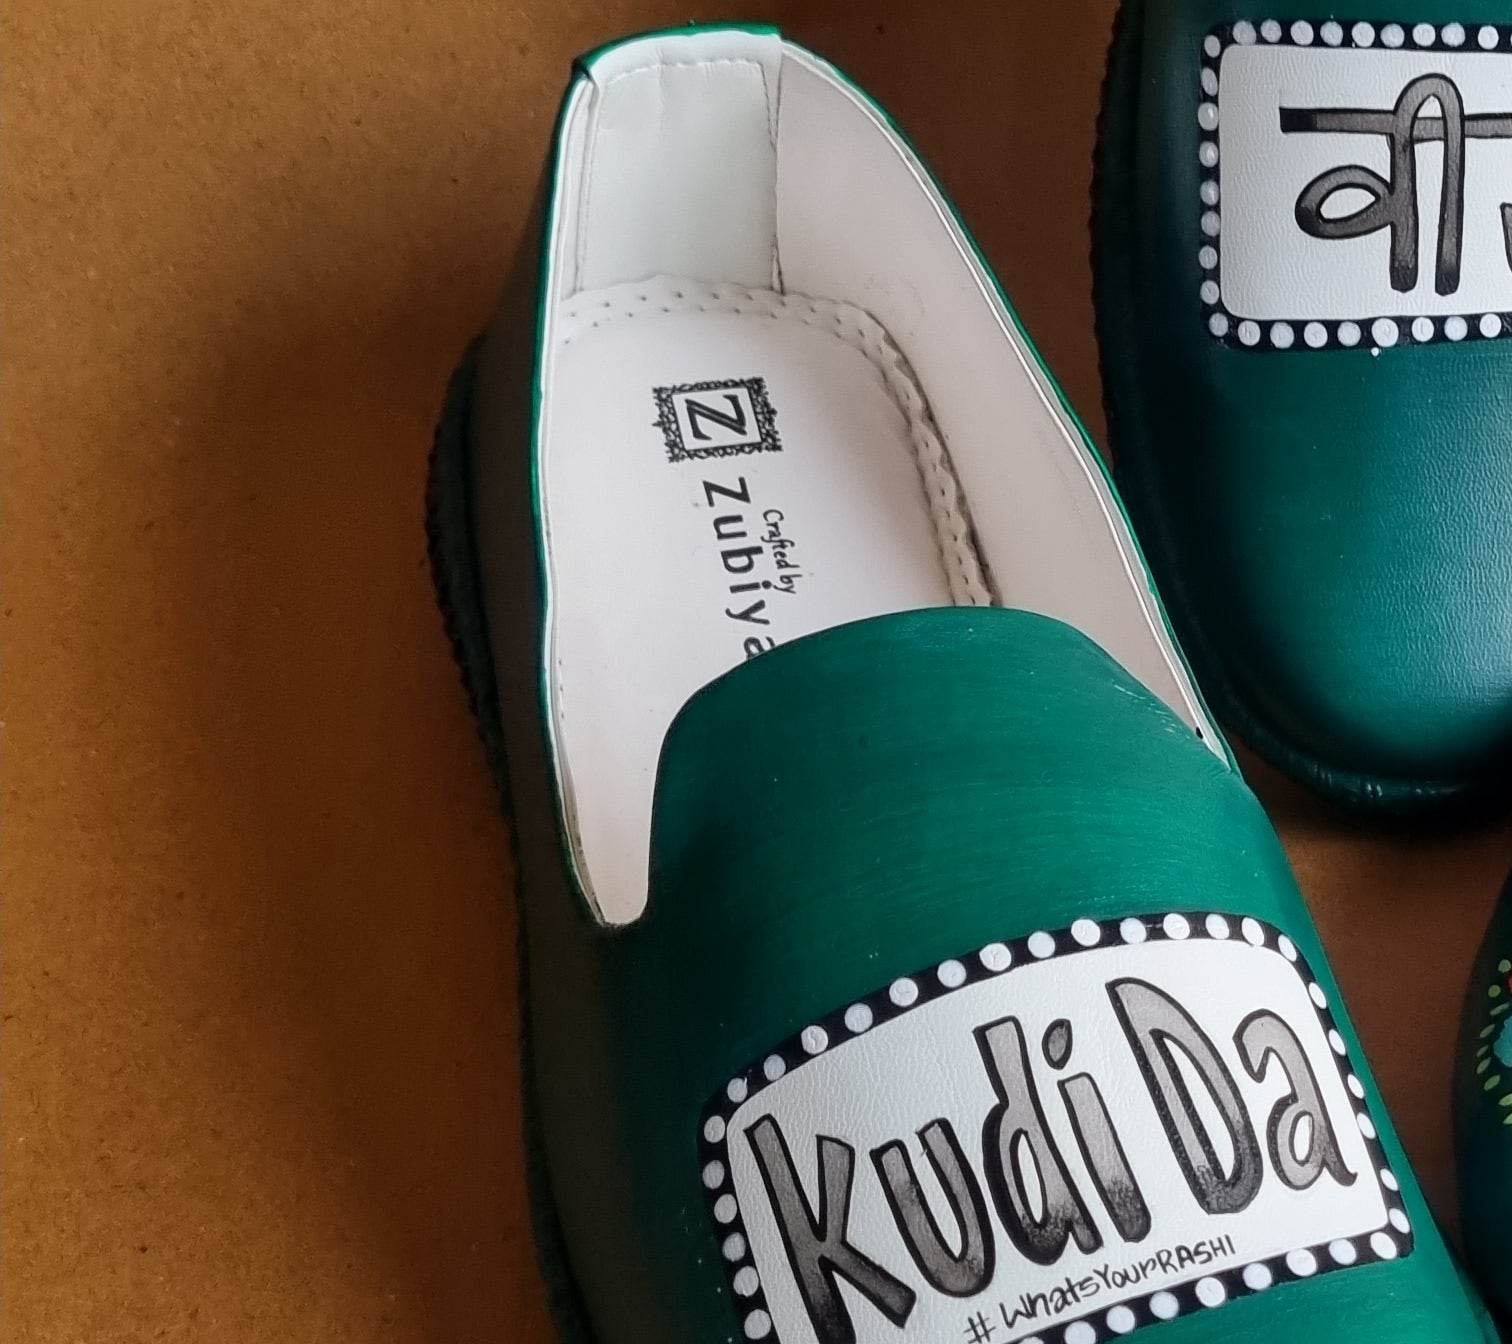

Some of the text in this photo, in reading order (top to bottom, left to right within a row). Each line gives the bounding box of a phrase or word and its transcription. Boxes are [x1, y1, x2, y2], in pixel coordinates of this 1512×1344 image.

[760, 508, 802, 595] Crafted by
[1104, 976, 1358, 1215] Da
